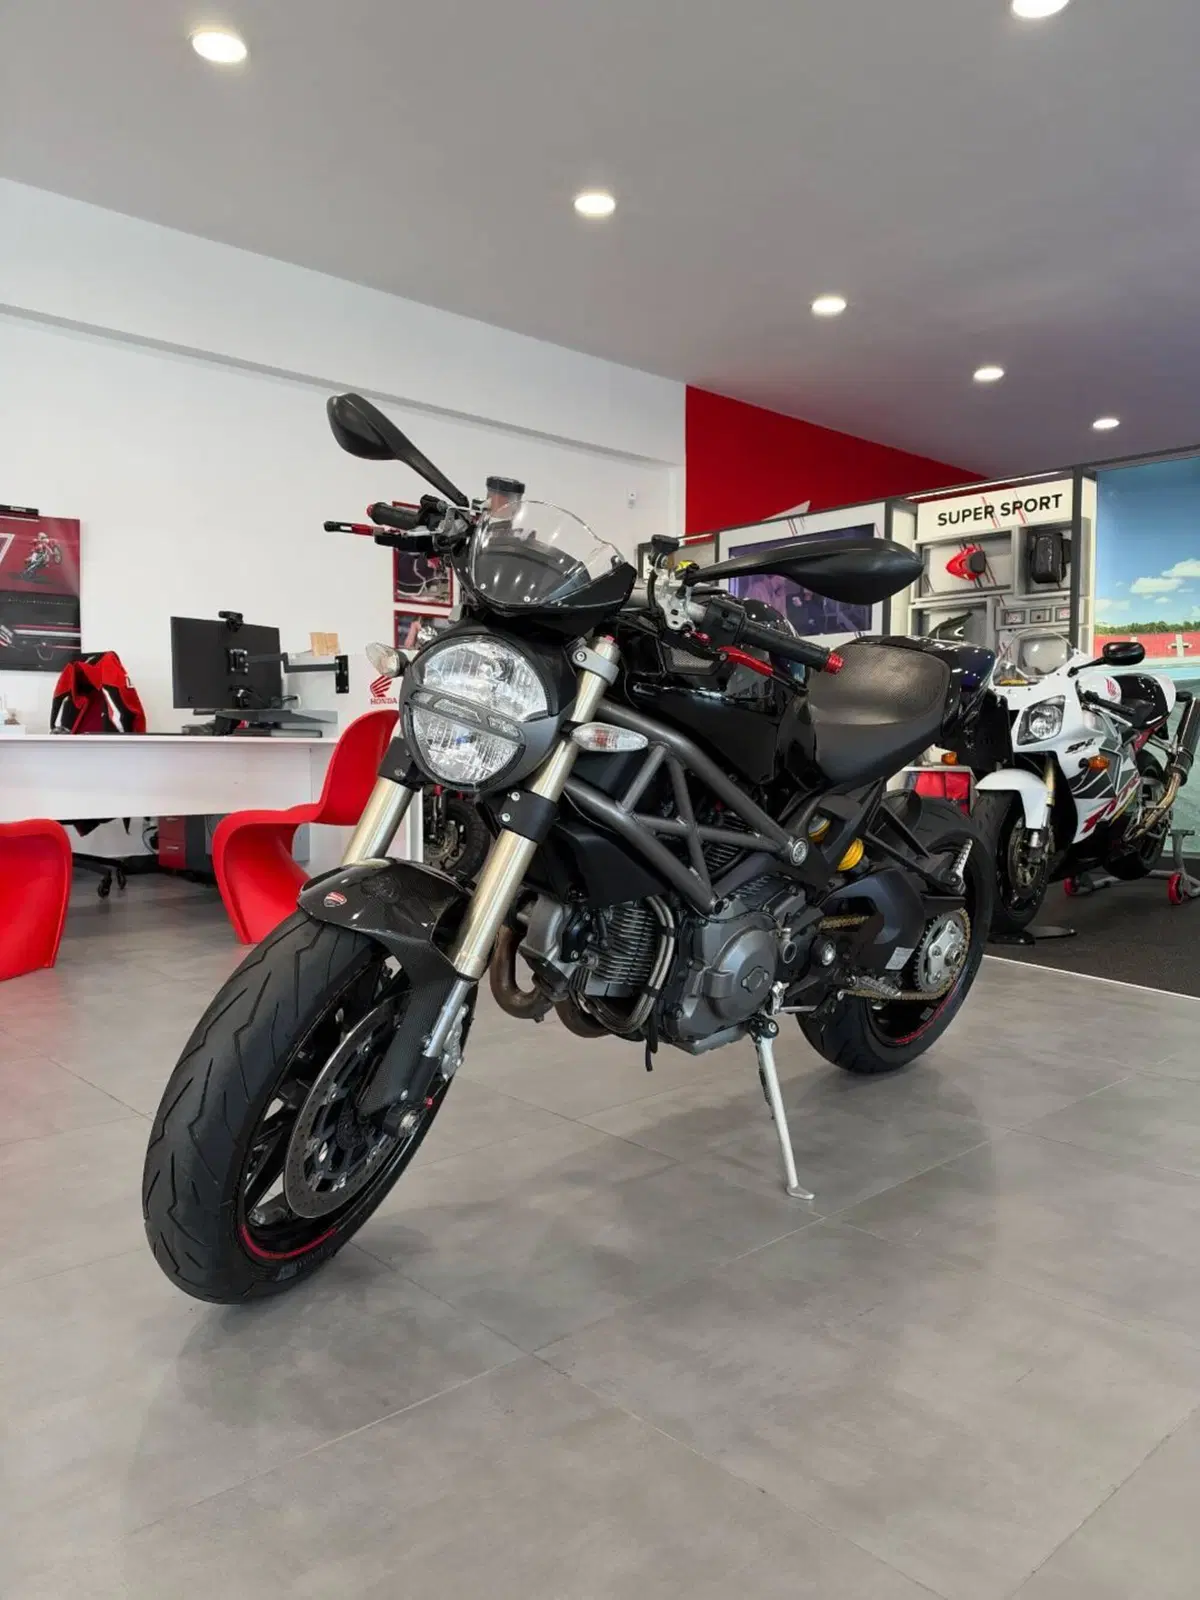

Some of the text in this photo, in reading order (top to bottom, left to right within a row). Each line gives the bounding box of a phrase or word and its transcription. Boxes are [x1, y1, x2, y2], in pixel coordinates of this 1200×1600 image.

[938, 493, 1063, 526] SUPER SPORT
[370, 697, 398, 705] HONDA
